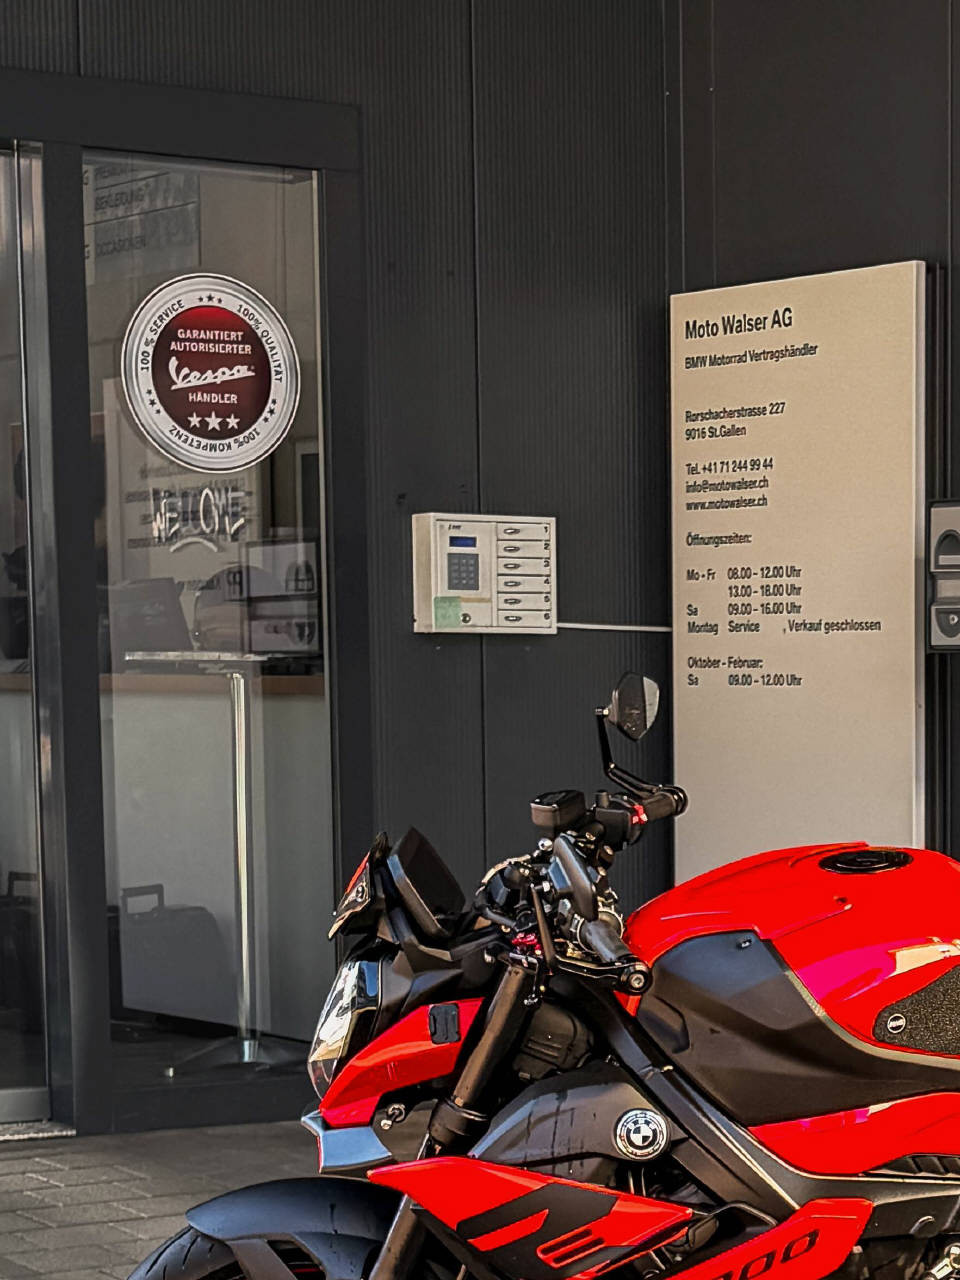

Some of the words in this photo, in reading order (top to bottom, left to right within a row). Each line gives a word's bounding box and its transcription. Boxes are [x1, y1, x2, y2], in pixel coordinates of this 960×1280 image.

[685, 319, 719, 339] Moto
[721, 313, 768, 335] Walser
[770, 307, 793, 328] AG
[140, 350, 150, 372] 100
[149, 299, 185, 336] SERVICE
[177, 329, 244, 341] GARANTIERT
[236, 303, 263, 331] 100%
[261, 329, 283, 384] QUALITÄT
[170, 341, 252, 355] AUTORISIERTER
[685, 355, 708, 369] BMW
[708, 350, 747, 367] Motorrad
[748, 343, 818, 362] Vertragshändler
[168, 356, 255, 390] Vespa
[188, 391, 238, 404] HÄNDLER
[685, 405, 767, 422] Rorschacherstrasse
[768, 402, 786, 415] 227
[168, 424, 233, 453] KOMPETENZ
[233, 427, 261, 449] 100%
[685, 427, 707, 441] 9016
[686, 462, 701, 475] Tel.
[702, 460, 718, 474] +41
[719, 459, 731, 473] 71
[731, 459, 748, 472] 244
[749, 458, 762, 471] 99
[762, 457, 774, 470] 44
[685, 476, 769, 494] info@motowalser.ch
[685, 494, 768, 511] www.motowalser.ch
[686, 531, 753, 548] Öffnungszeiten:
[686, 568, 700, 581] Mo
[707, 568, 716, 580] Fr
[727, 567, 752, 580] 08.00
[760, 566, 784, 579] 12.00
[785, 565, 802, 579] Uhr
[728, 585, 752, 598] 13.00
[760, 584, 784, 597] 18.00
[785, 583, 802, 597] Uhr
[686, 604, 698, 617] Sa
[727, 602, 752, 616] 09.00
[760, 602, 784, 615] 16.00
[785, 601, 802, 615] Uhr
[687, 621, 718, 635] Montag
[728, 620, 760, 633] Service
[788, 619, 822, 632] Verkauf
[823, 617, 881, 634] geschlossen
[687, 656, 720, 669] Oktober
[687, 674, 698, 686] Sa
[728, 674, 752, 686] 09.00
[761, 673, 785, 686] 12.00
[785, 673, 802, 686] Uhr
